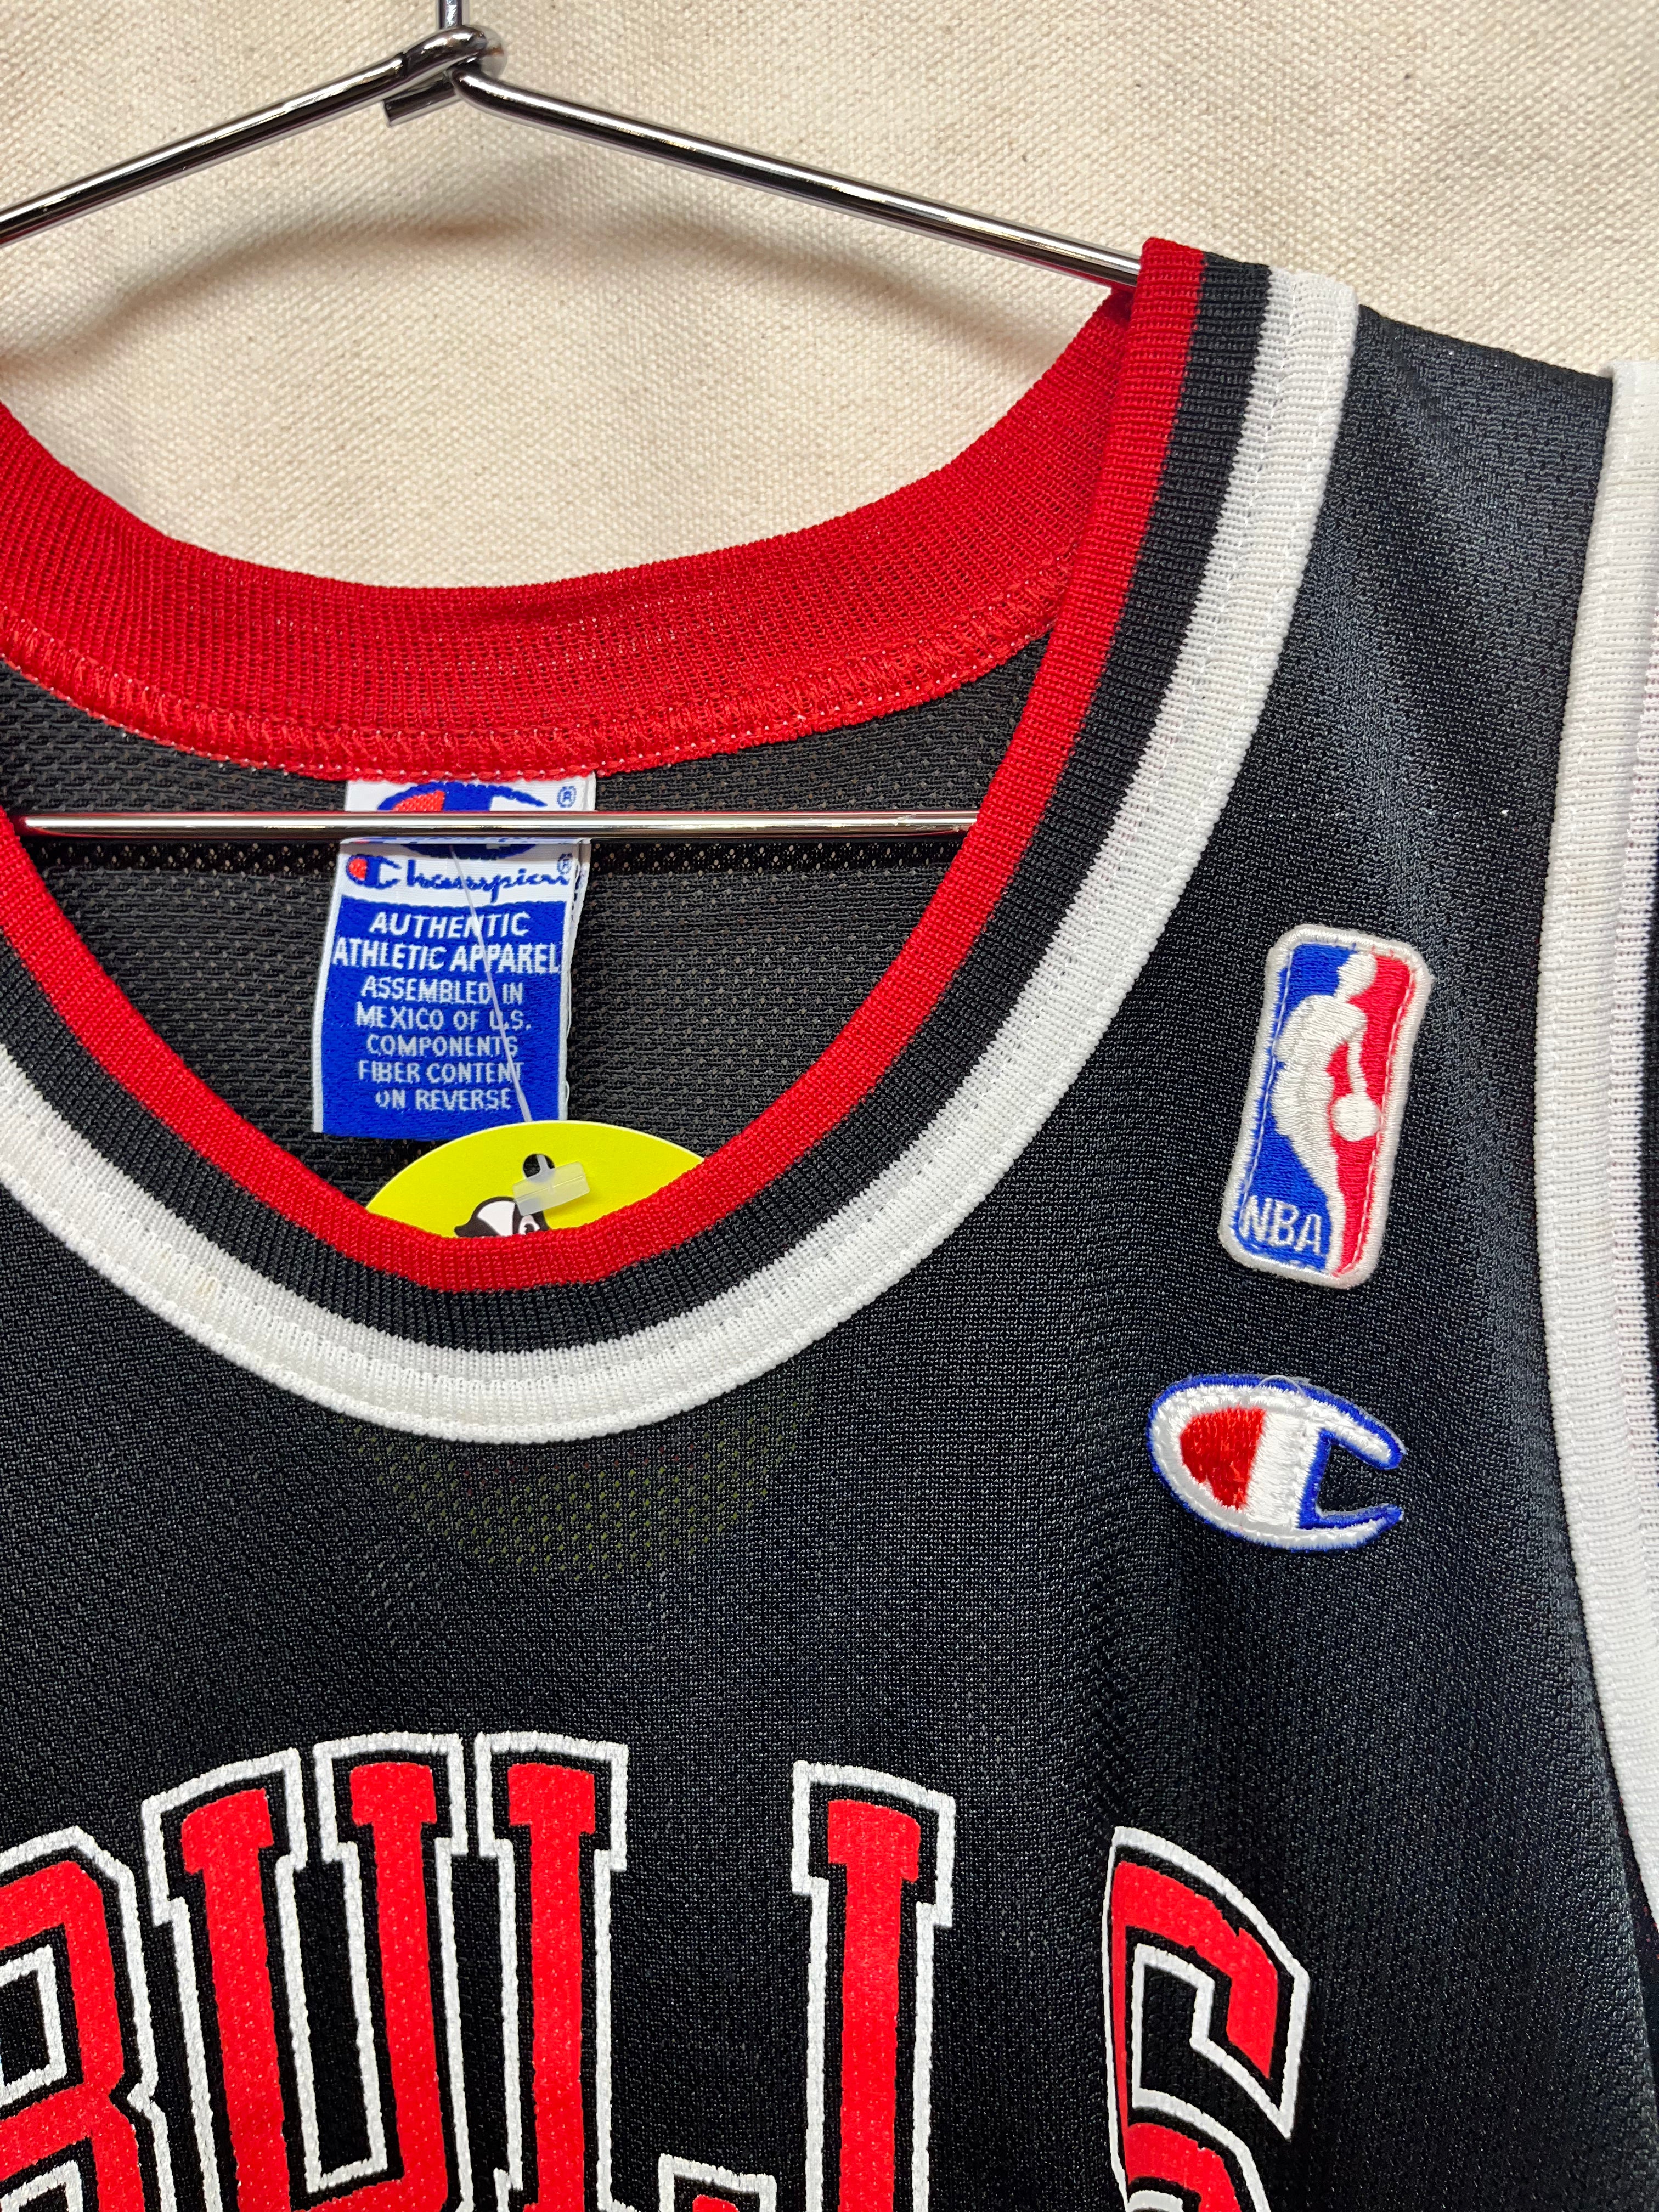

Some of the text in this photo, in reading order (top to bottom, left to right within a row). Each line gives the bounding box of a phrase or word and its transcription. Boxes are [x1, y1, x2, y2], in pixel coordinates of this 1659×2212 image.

[368, 911, 531, 939] AUTHENTIC
[332, 936, 559, 974] ATHLETIC APPAREL
[360, 975, 524, 1005] ASSEMBLED IN
[356, 1001, 532, 1031] MEXICO OF U.S.
[366, 1032, 518, 1057] COMPONENTS
[358, 1060, 524, 1085] FIBER CONTENT
[374, 1087, 512, 1111] ON REVERSE
[1239, 1194, 1322, 1256] NBA
